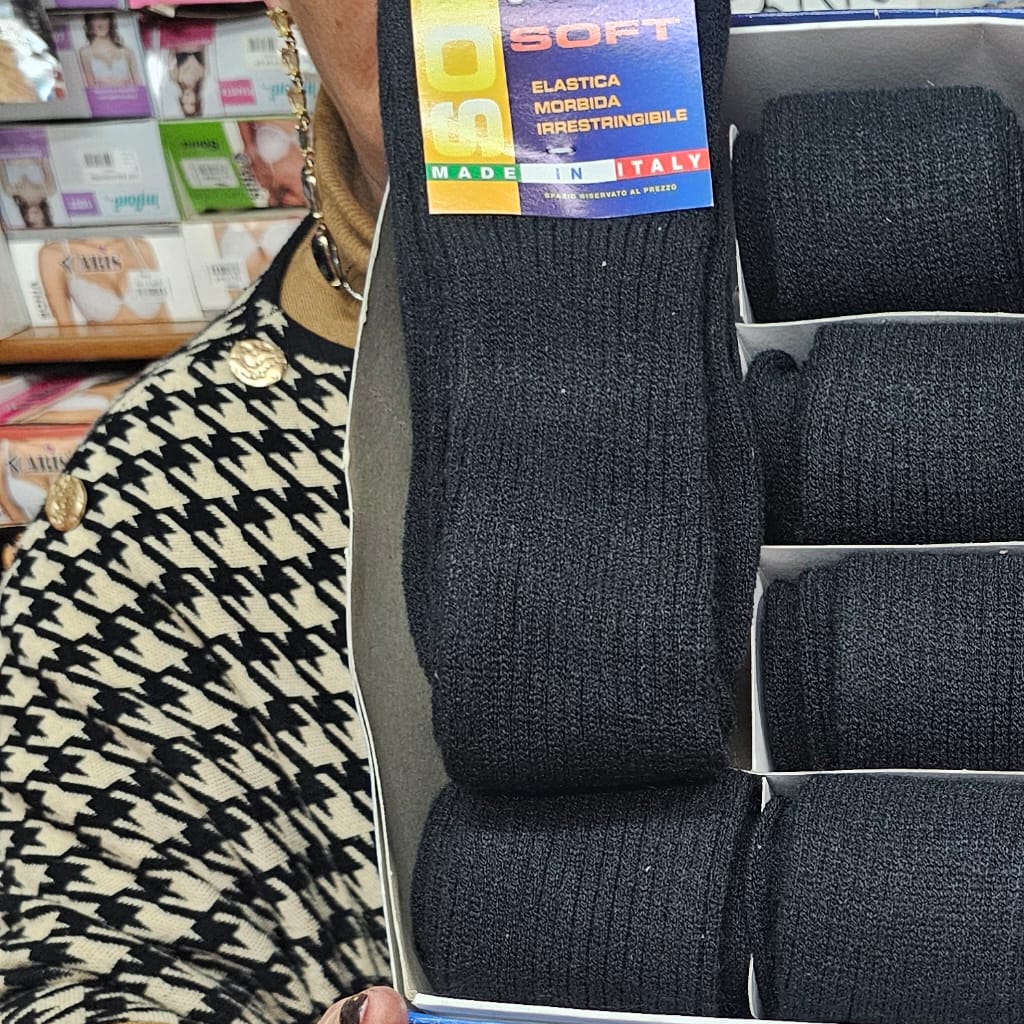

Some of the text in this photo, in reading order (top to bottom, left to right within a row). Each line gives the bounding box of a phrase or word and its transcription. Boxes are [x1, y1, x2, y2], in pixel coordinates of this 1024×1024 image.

[509, 16, 681, 52] SOFT
[531, 74, 621, 94] ELASTICA
[534, 95, 622, 115] MORBIDA
[536, 108, 688, 136] IRRESTRINGIBILE
[431, 153, 702, 181] MADE IN ITALY
[544, 183, 678, 200] SPAZIO RISERVATO AL PREZZO
